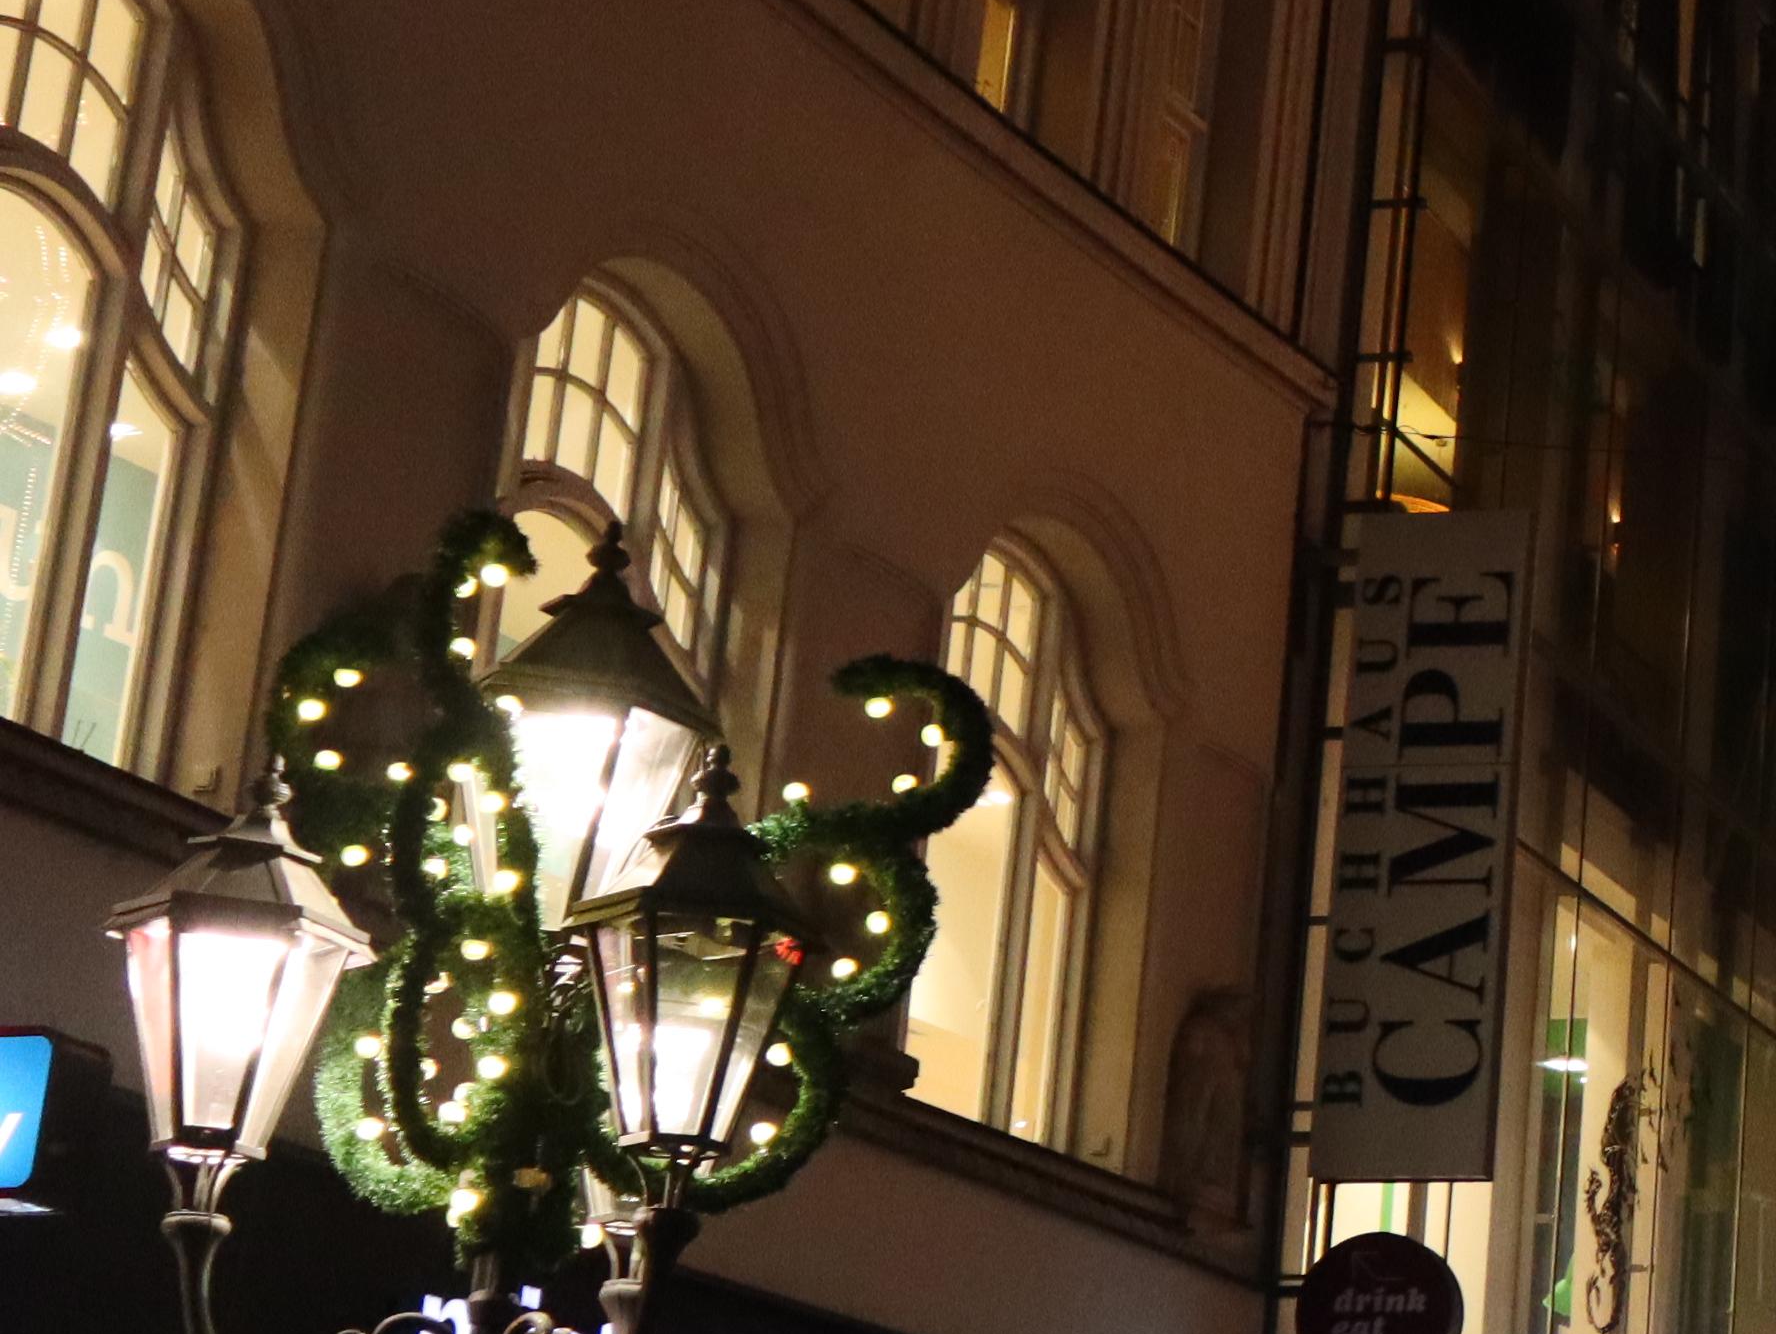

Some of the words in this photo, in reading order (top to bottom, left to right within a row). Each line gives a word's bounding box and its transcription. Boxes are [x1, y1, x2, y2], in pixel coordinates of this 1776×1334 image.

[1320, 574, 1404, 1109] BUCHHAUS
[1371, 571, 1515, 1107] CAMPE
[1333, 1286, 1427, 1313] drink
